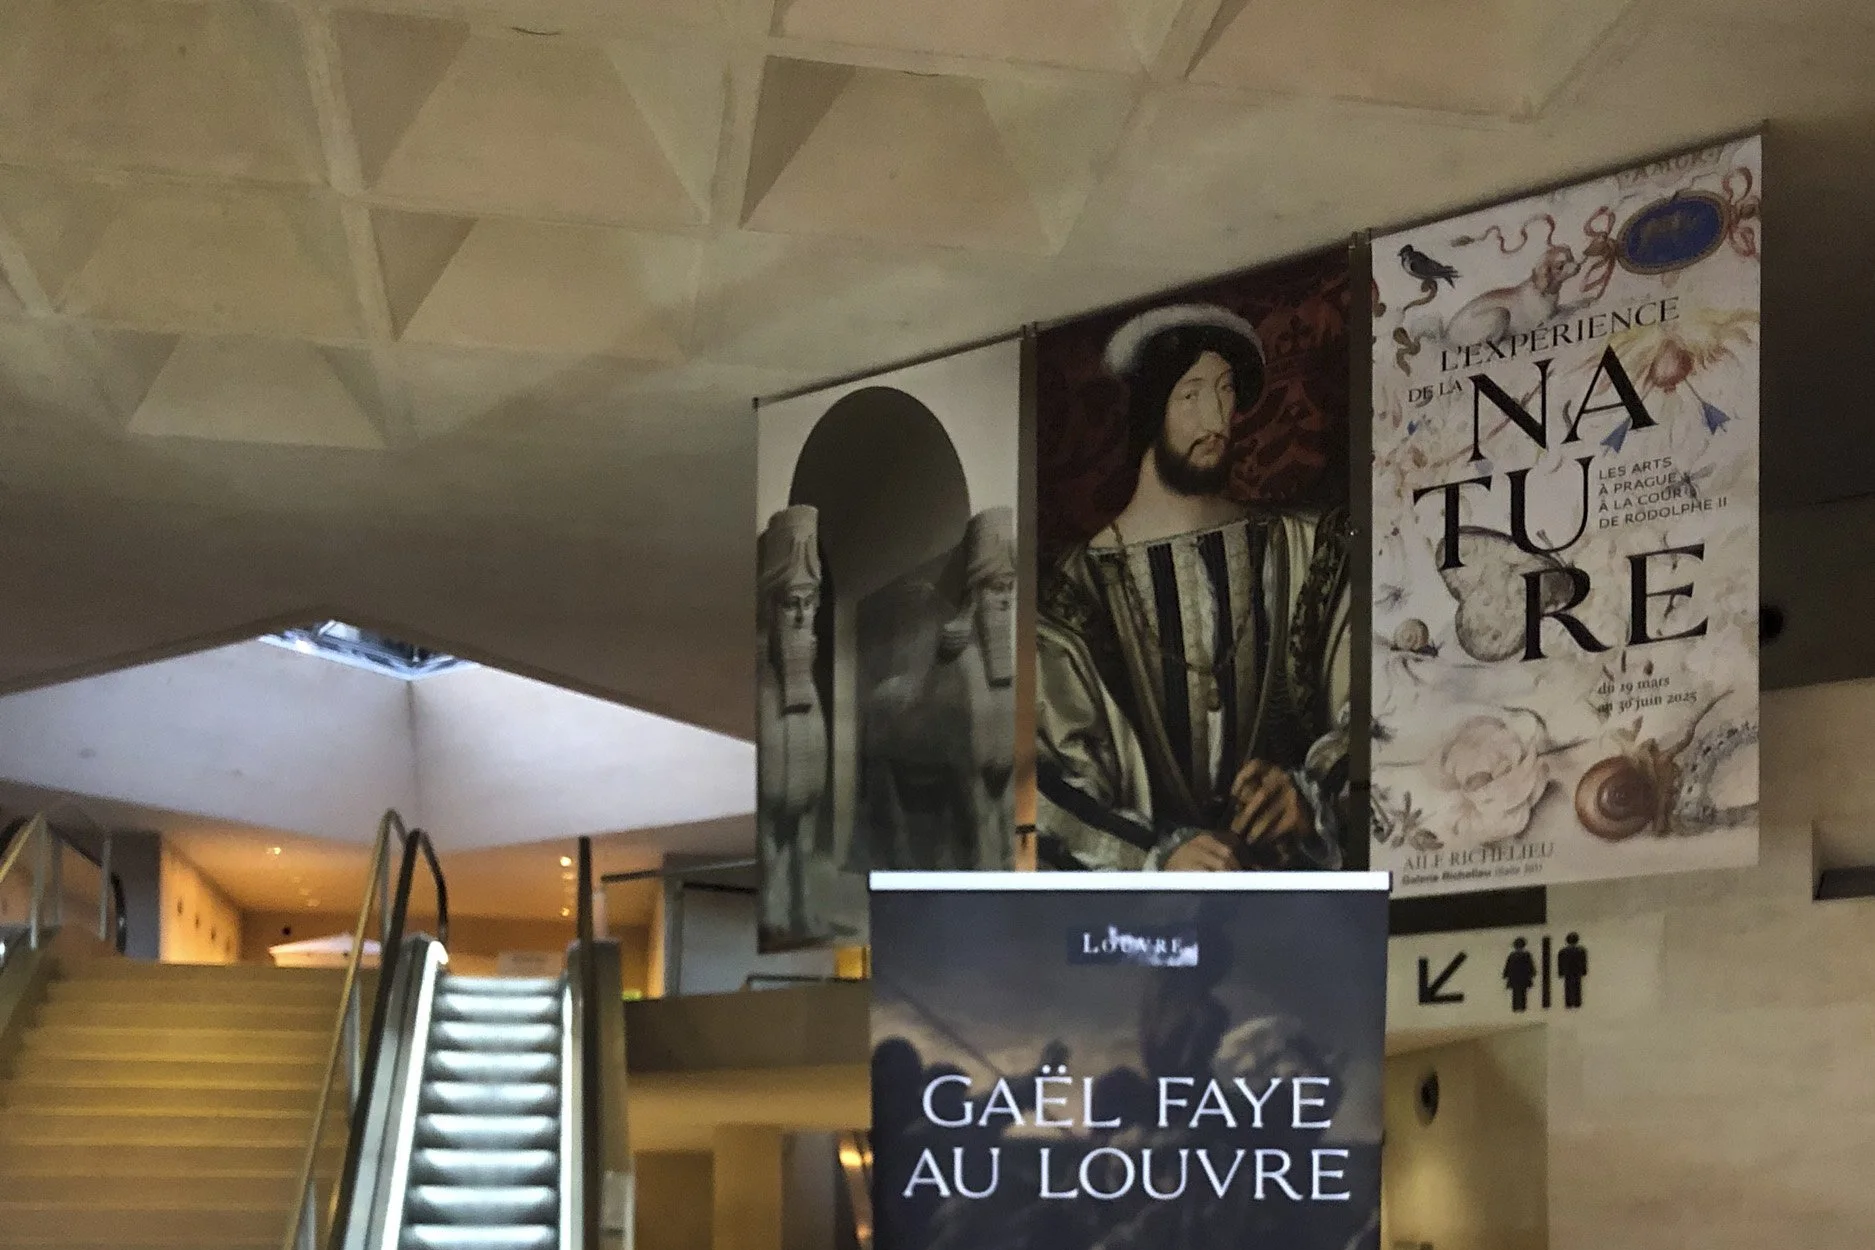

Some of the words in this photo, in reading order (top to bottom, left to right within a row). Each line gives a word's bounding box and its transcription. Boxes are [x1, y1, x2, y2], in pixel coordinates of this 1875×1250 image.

[1440, 297, 1679, 372] L'EXPÉRIENCE
[1408, 387, 1434, 403] DE
[1438, 377, 1463, 398] LA
[1599, 465, 1627, 481] LES
[1631, 456, 1673, 475] ARTS
[1598, 483, 1609, 497] À
[1614, 472, 1677, 494] PRAGUE
[1614, 497, 1633, 511] LA
[1637, 487, 1682, 505] COUR
[1599, 516, 1619, 530] DE
[1625, 499, 1713, 525] RODOLPHE
[1718, 496, 1728, 508] II
[1637, 676, 1671, 690] mars
[1635, 695, 1663, 711] juin
[1667, 690, 1698, 705] 2025
[1450, 841, 1555, 867] RICHELIEU
[921, 1064, 1121, 1129] GAËL
[1156, 1076, 1332, 1129] FAYE
[902, 1147, 1001, 1200] AU
[1038, 1146, 1352, 1201] LOUVRE
